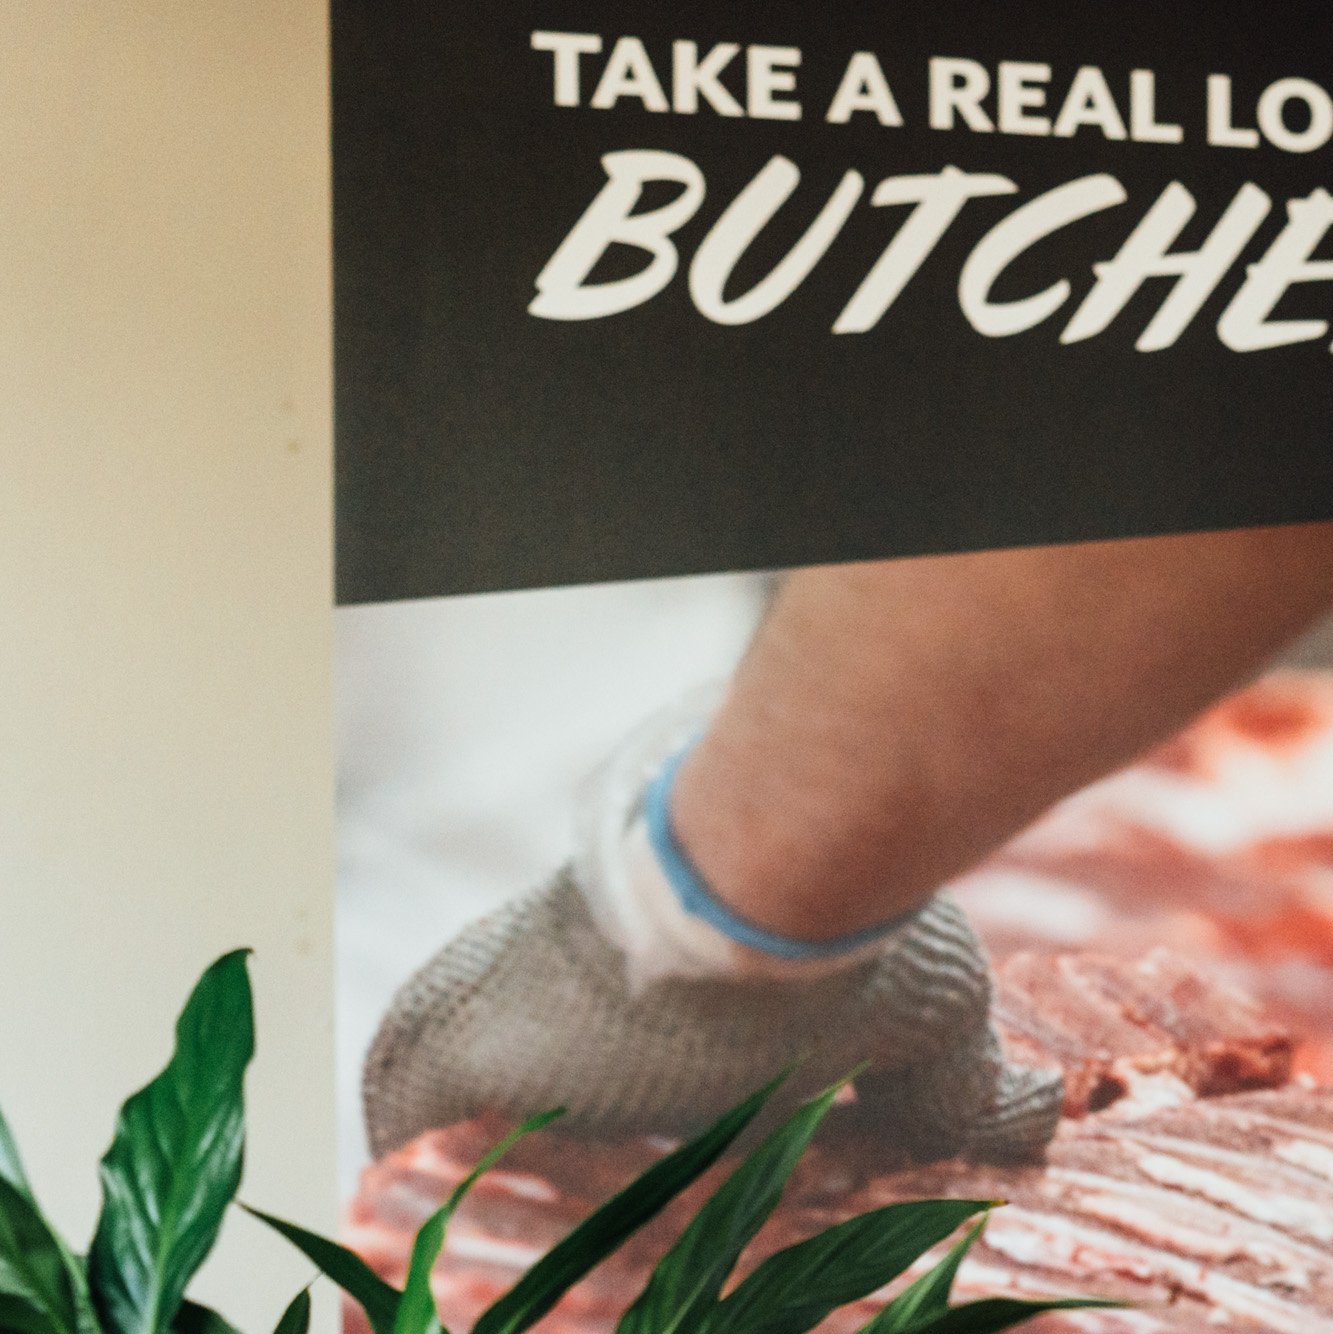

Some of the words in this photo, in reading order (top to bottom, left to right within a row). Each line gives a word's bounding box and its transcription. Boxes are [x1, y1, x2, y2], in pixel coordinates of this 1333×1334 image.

[530, 30, 803, 121] TAKE
[826, 51, 904, 127] A
[928, 56, 1184, 144] REAL
